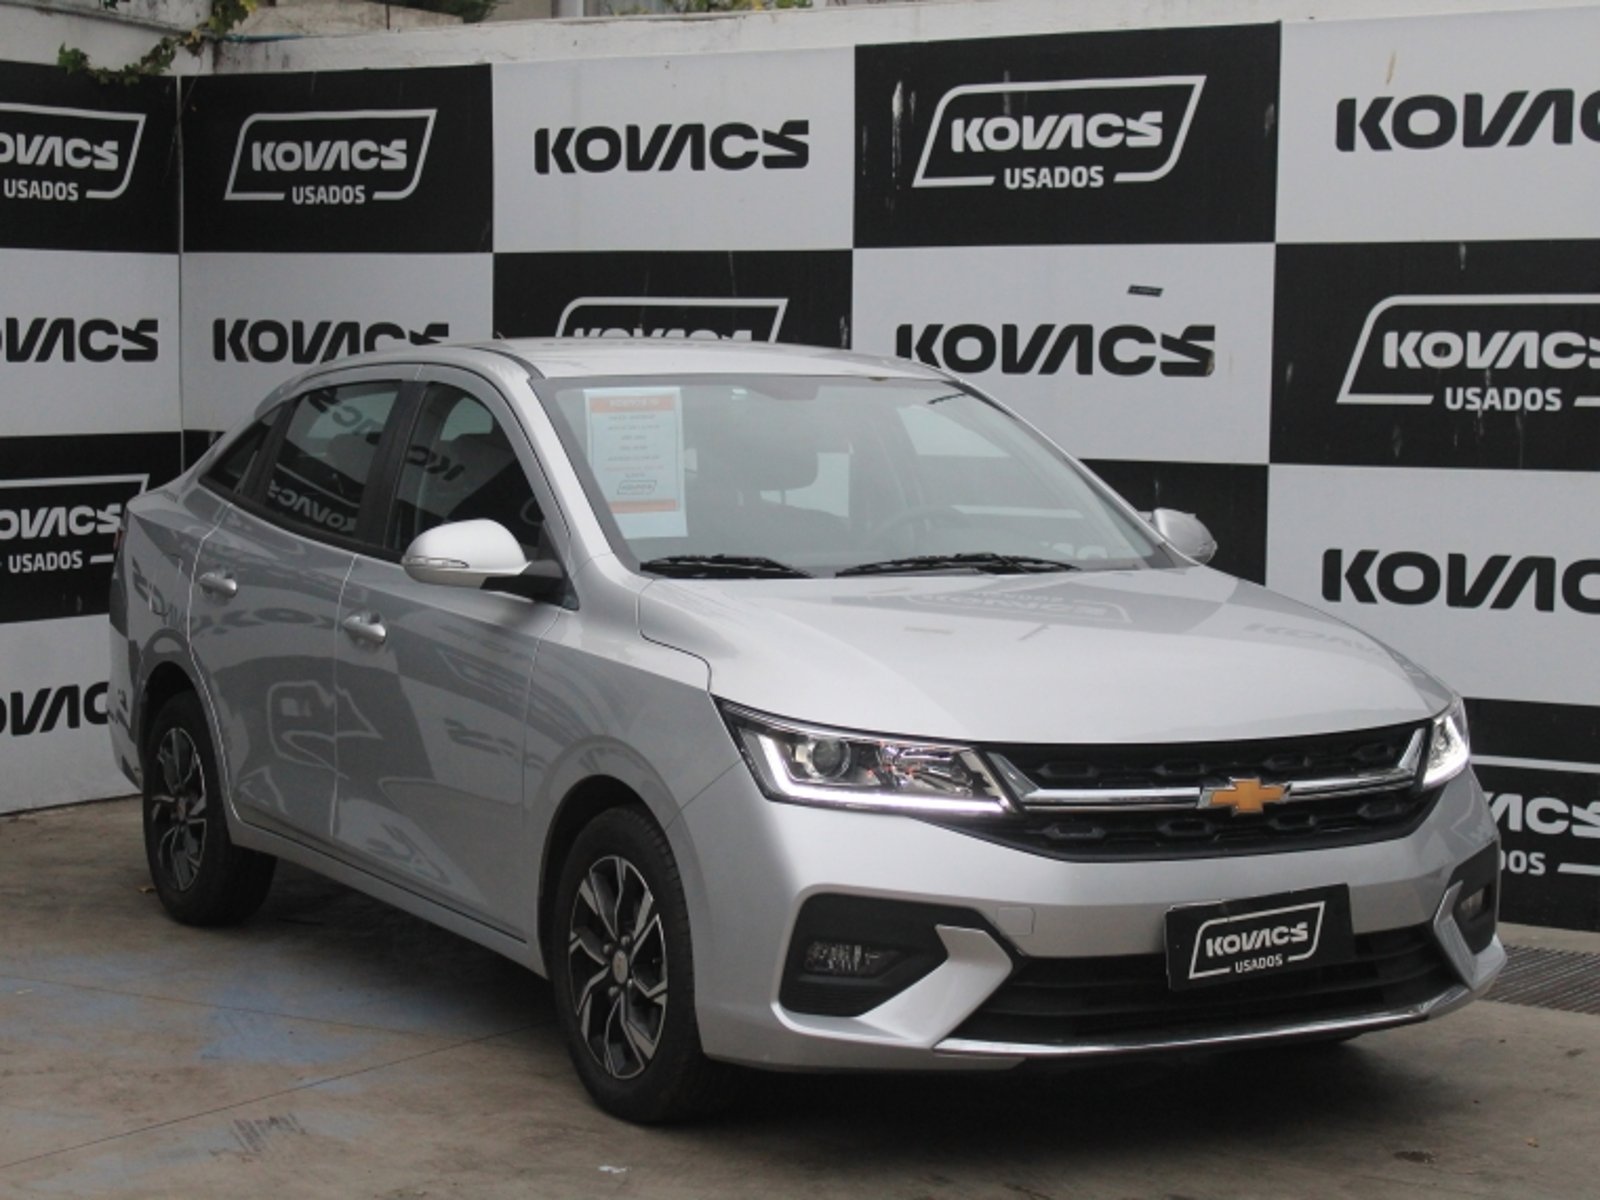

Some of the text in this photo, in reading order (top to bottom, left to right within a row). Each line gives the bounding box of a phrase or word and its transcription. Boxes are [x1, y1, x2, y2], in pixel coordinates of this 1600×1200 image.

[534, 120, 809, 175] KOVACS
[951, 110, 1163, 153] KOVACS
[252, 139, 407, 172] KOVACS
[4, 178, 79, 201] USADOS
[292, 185, 366, 205] USADOS
[1004, 166, 1104, 189] USADOS
[0, 317, 158, 363] VACS
[896, 323, 1215, 377] KOVACS
[1383, 331, 1600, 369] KOVAC
[1445, 386, 1563, 412] USADOS
[8, 550, 83, 574] USADOS
[0, 681, 109, 737] VAC
[1205, 921, 1309, 958] KOVACS
[1235, 953, 1283, 973] USADOS
